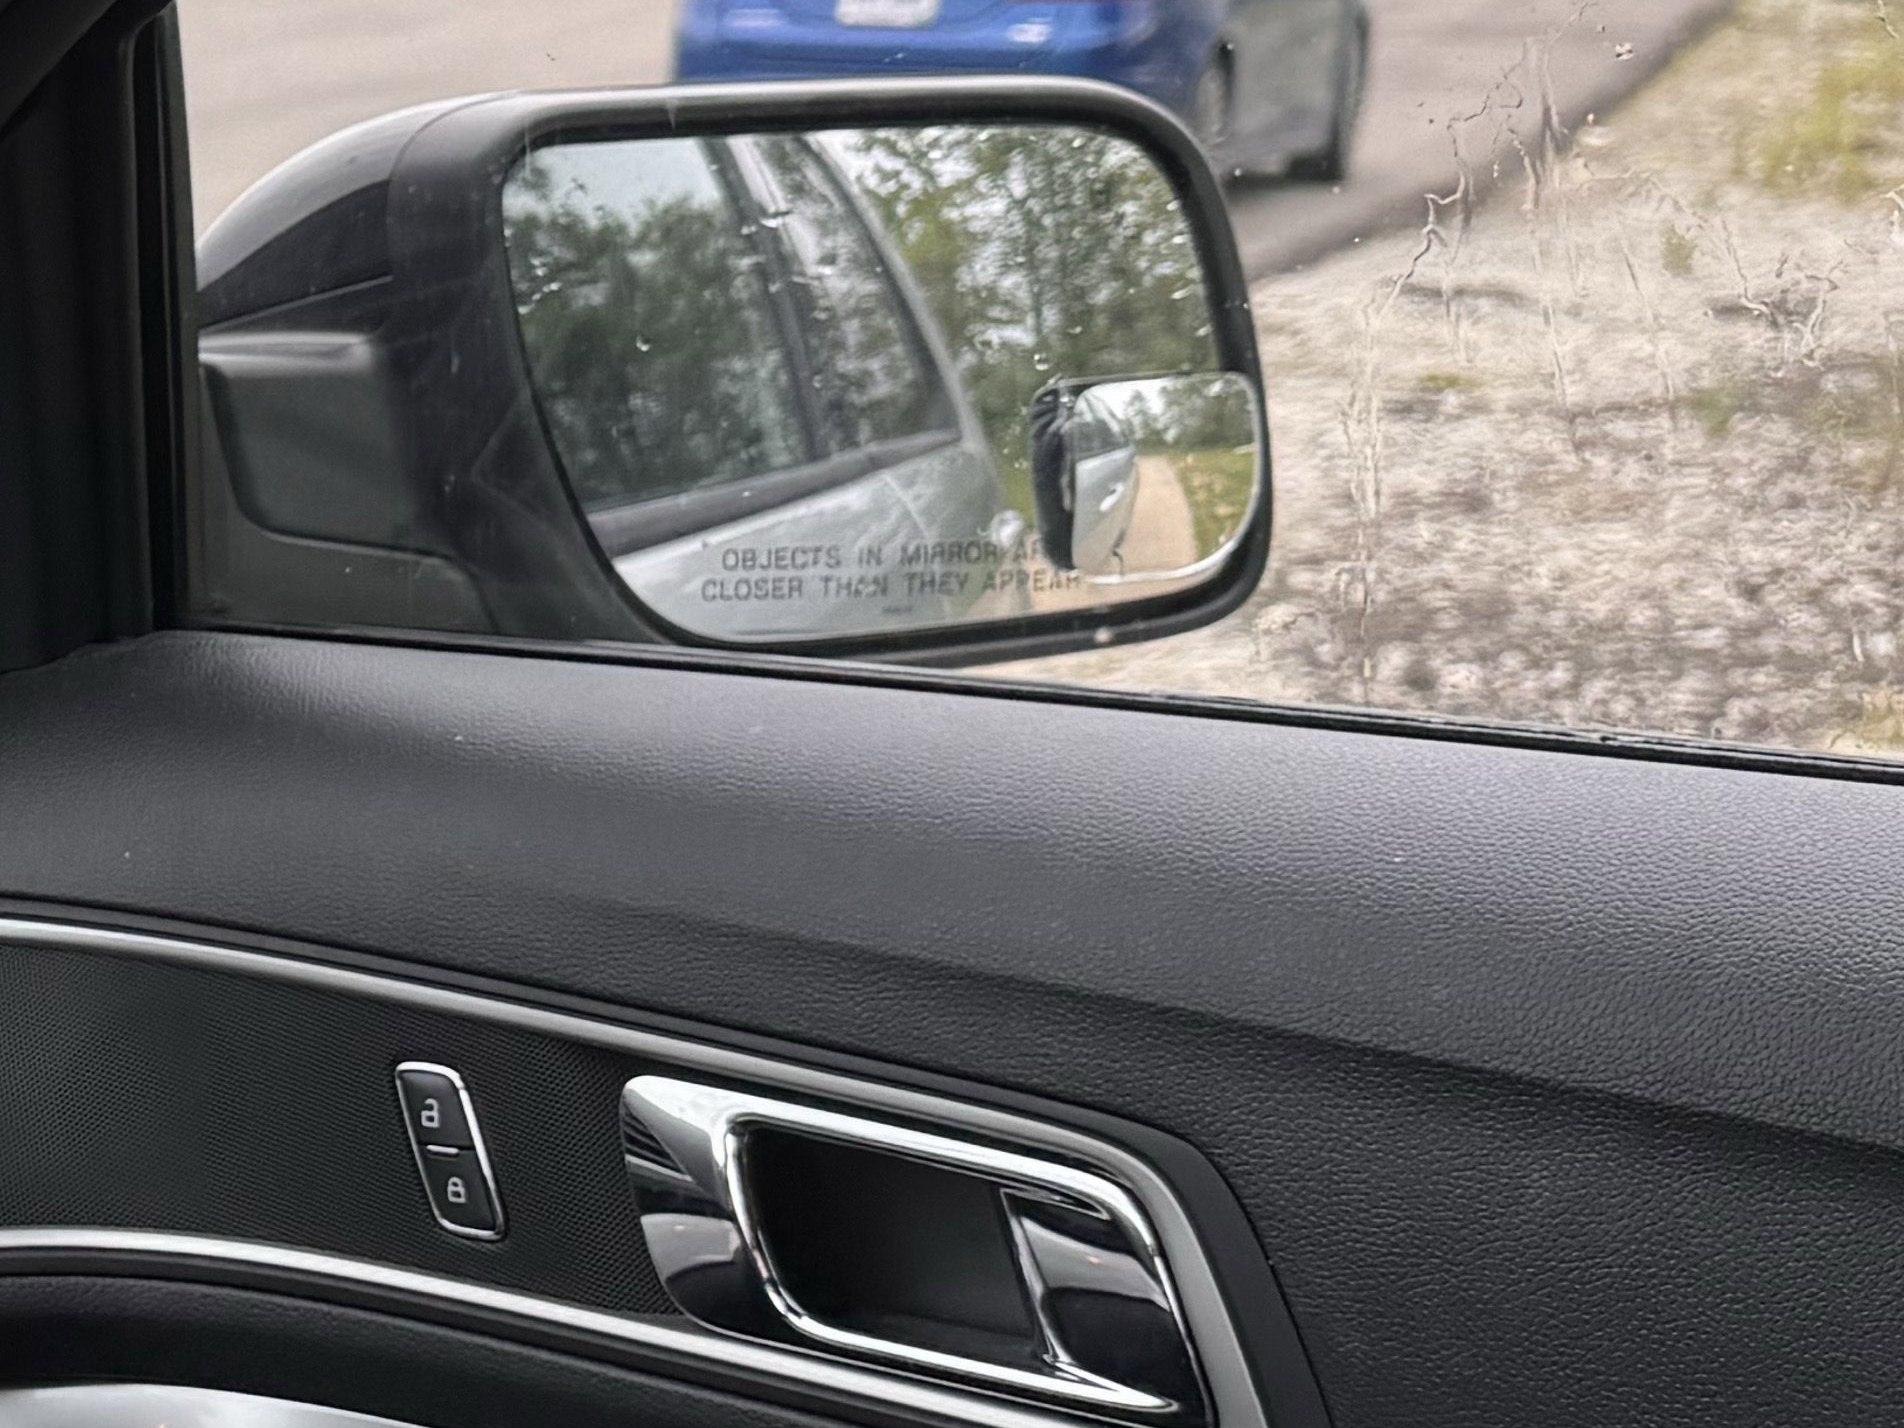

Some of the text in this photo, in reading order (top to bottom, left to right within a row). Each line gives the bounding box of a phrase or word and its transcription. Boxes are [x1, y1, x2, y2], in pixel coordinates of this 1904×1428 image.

[722, 545, 842, 571] OBJECTS
[858, 543, 884, 568] IN
[899, 539, 998, 566] MIRROR
[701, 575, 804, 602] CLOSER
[819, 574, 889, 599] THAN
[905, 572, 969, 596] THEY
